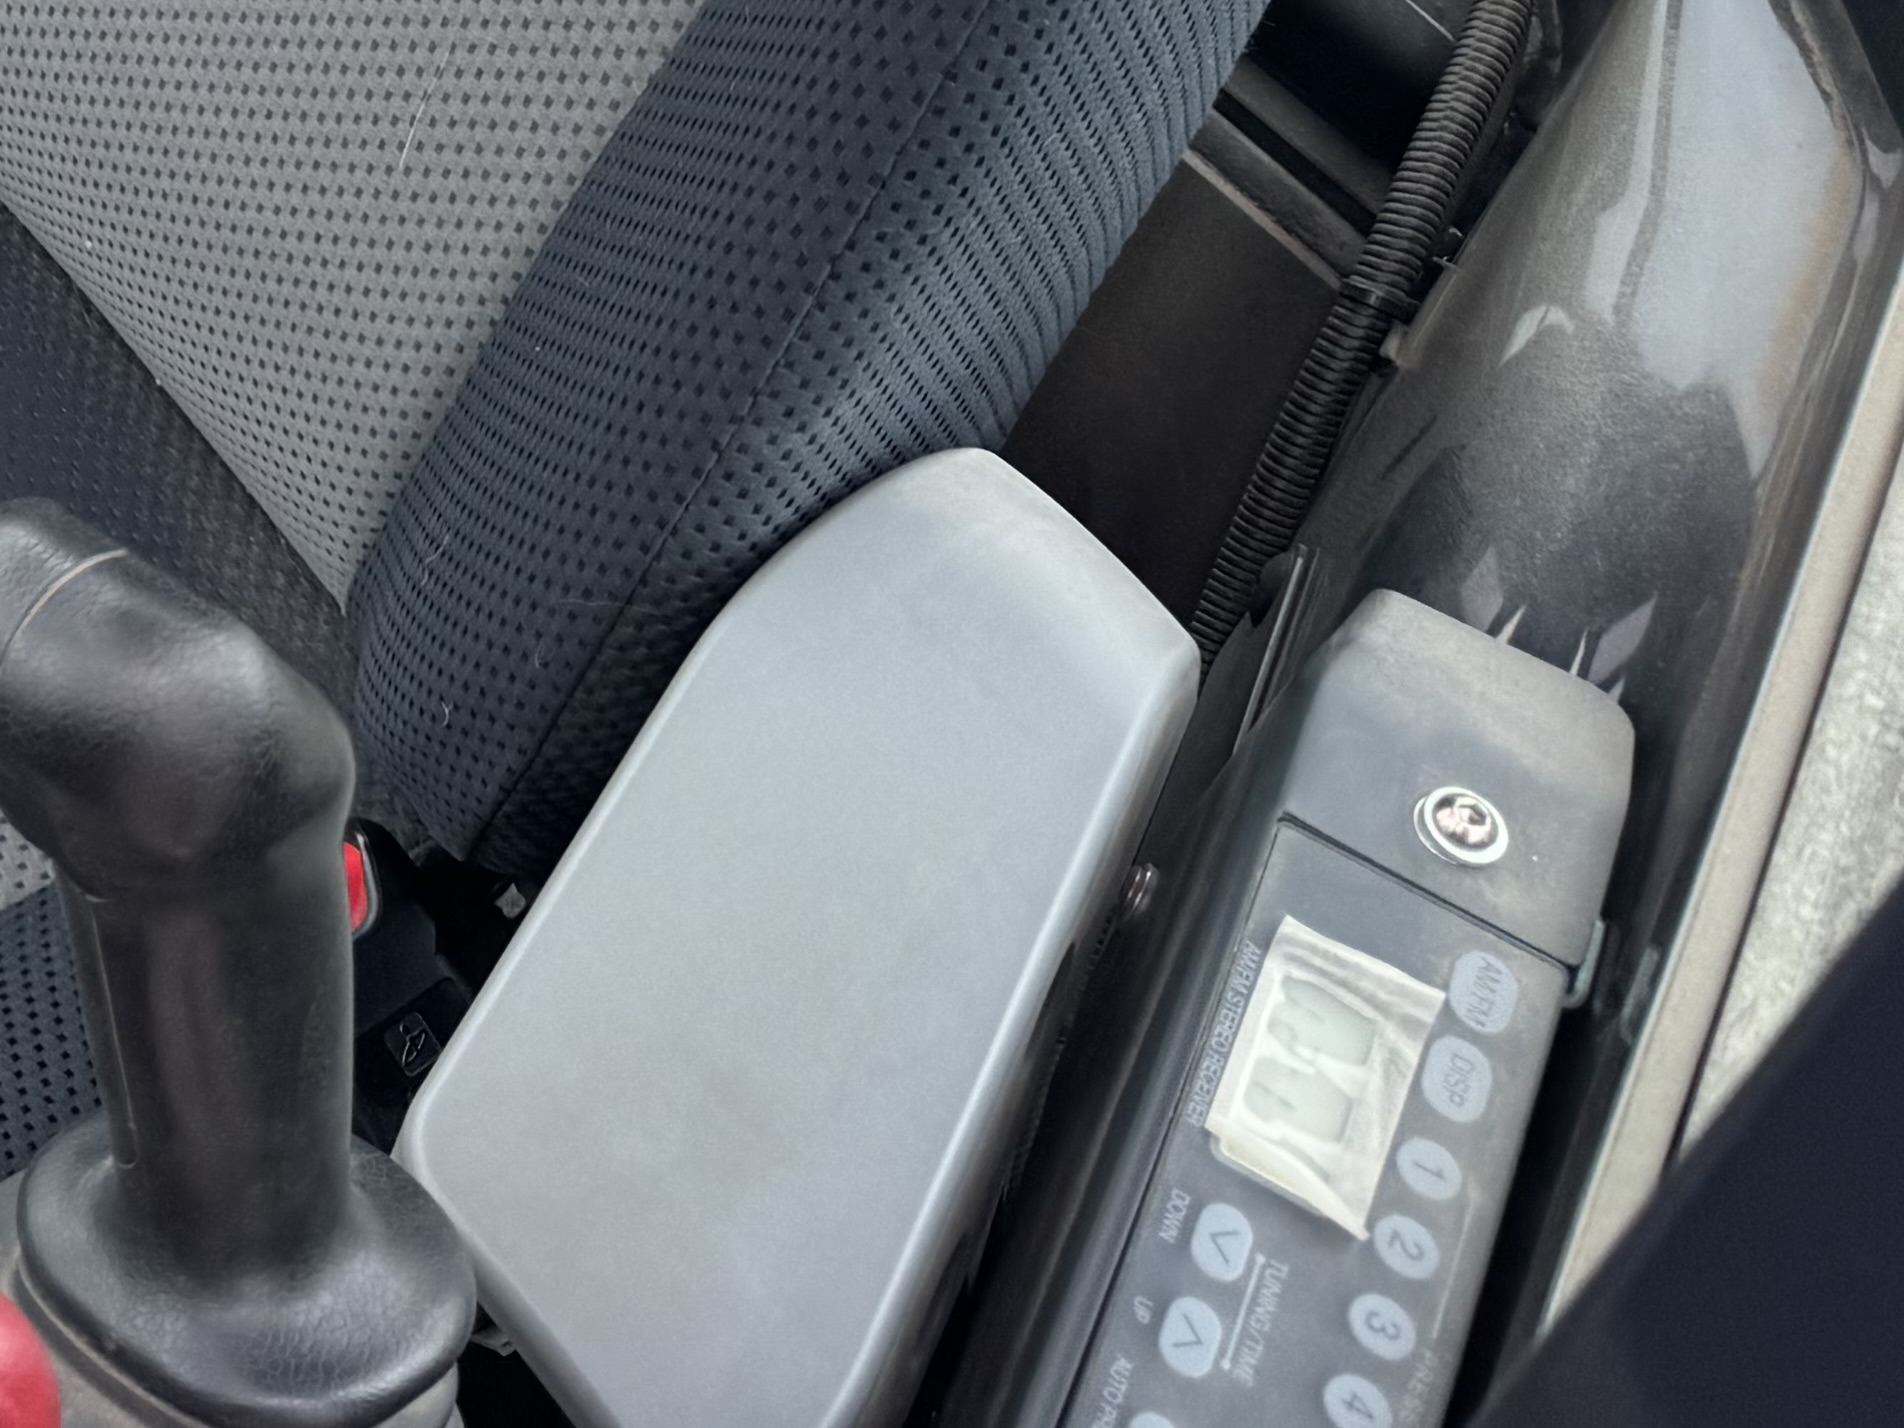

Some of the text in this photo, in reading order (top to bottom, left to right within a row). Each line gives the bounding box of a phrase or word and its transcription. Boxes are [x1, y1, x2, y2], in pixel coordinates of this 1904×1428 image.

[1464, 956, 1504, 1028] AM/FM
[1211, 991, 1248, 1052] STEREO
[1183, 1052, 1225, 1127] RECEIVER
[1441, 1052, 1476, 1108] DISP
[1414, 1160, 1446, 1180] 1
[1159, 1188, 1191, 1244] DOWN
[1390, 1229, 1425, 1262] 2
[1134, 1295, 1154, 1325] UP
[1231, 1258, 1289, 1388] TUNING/TIME
[1366, 1310, 1402, 1343] 3
[1102, 1357, 1132, 1405] AUTO
[1342, 1391, 1374, 1420] 4
